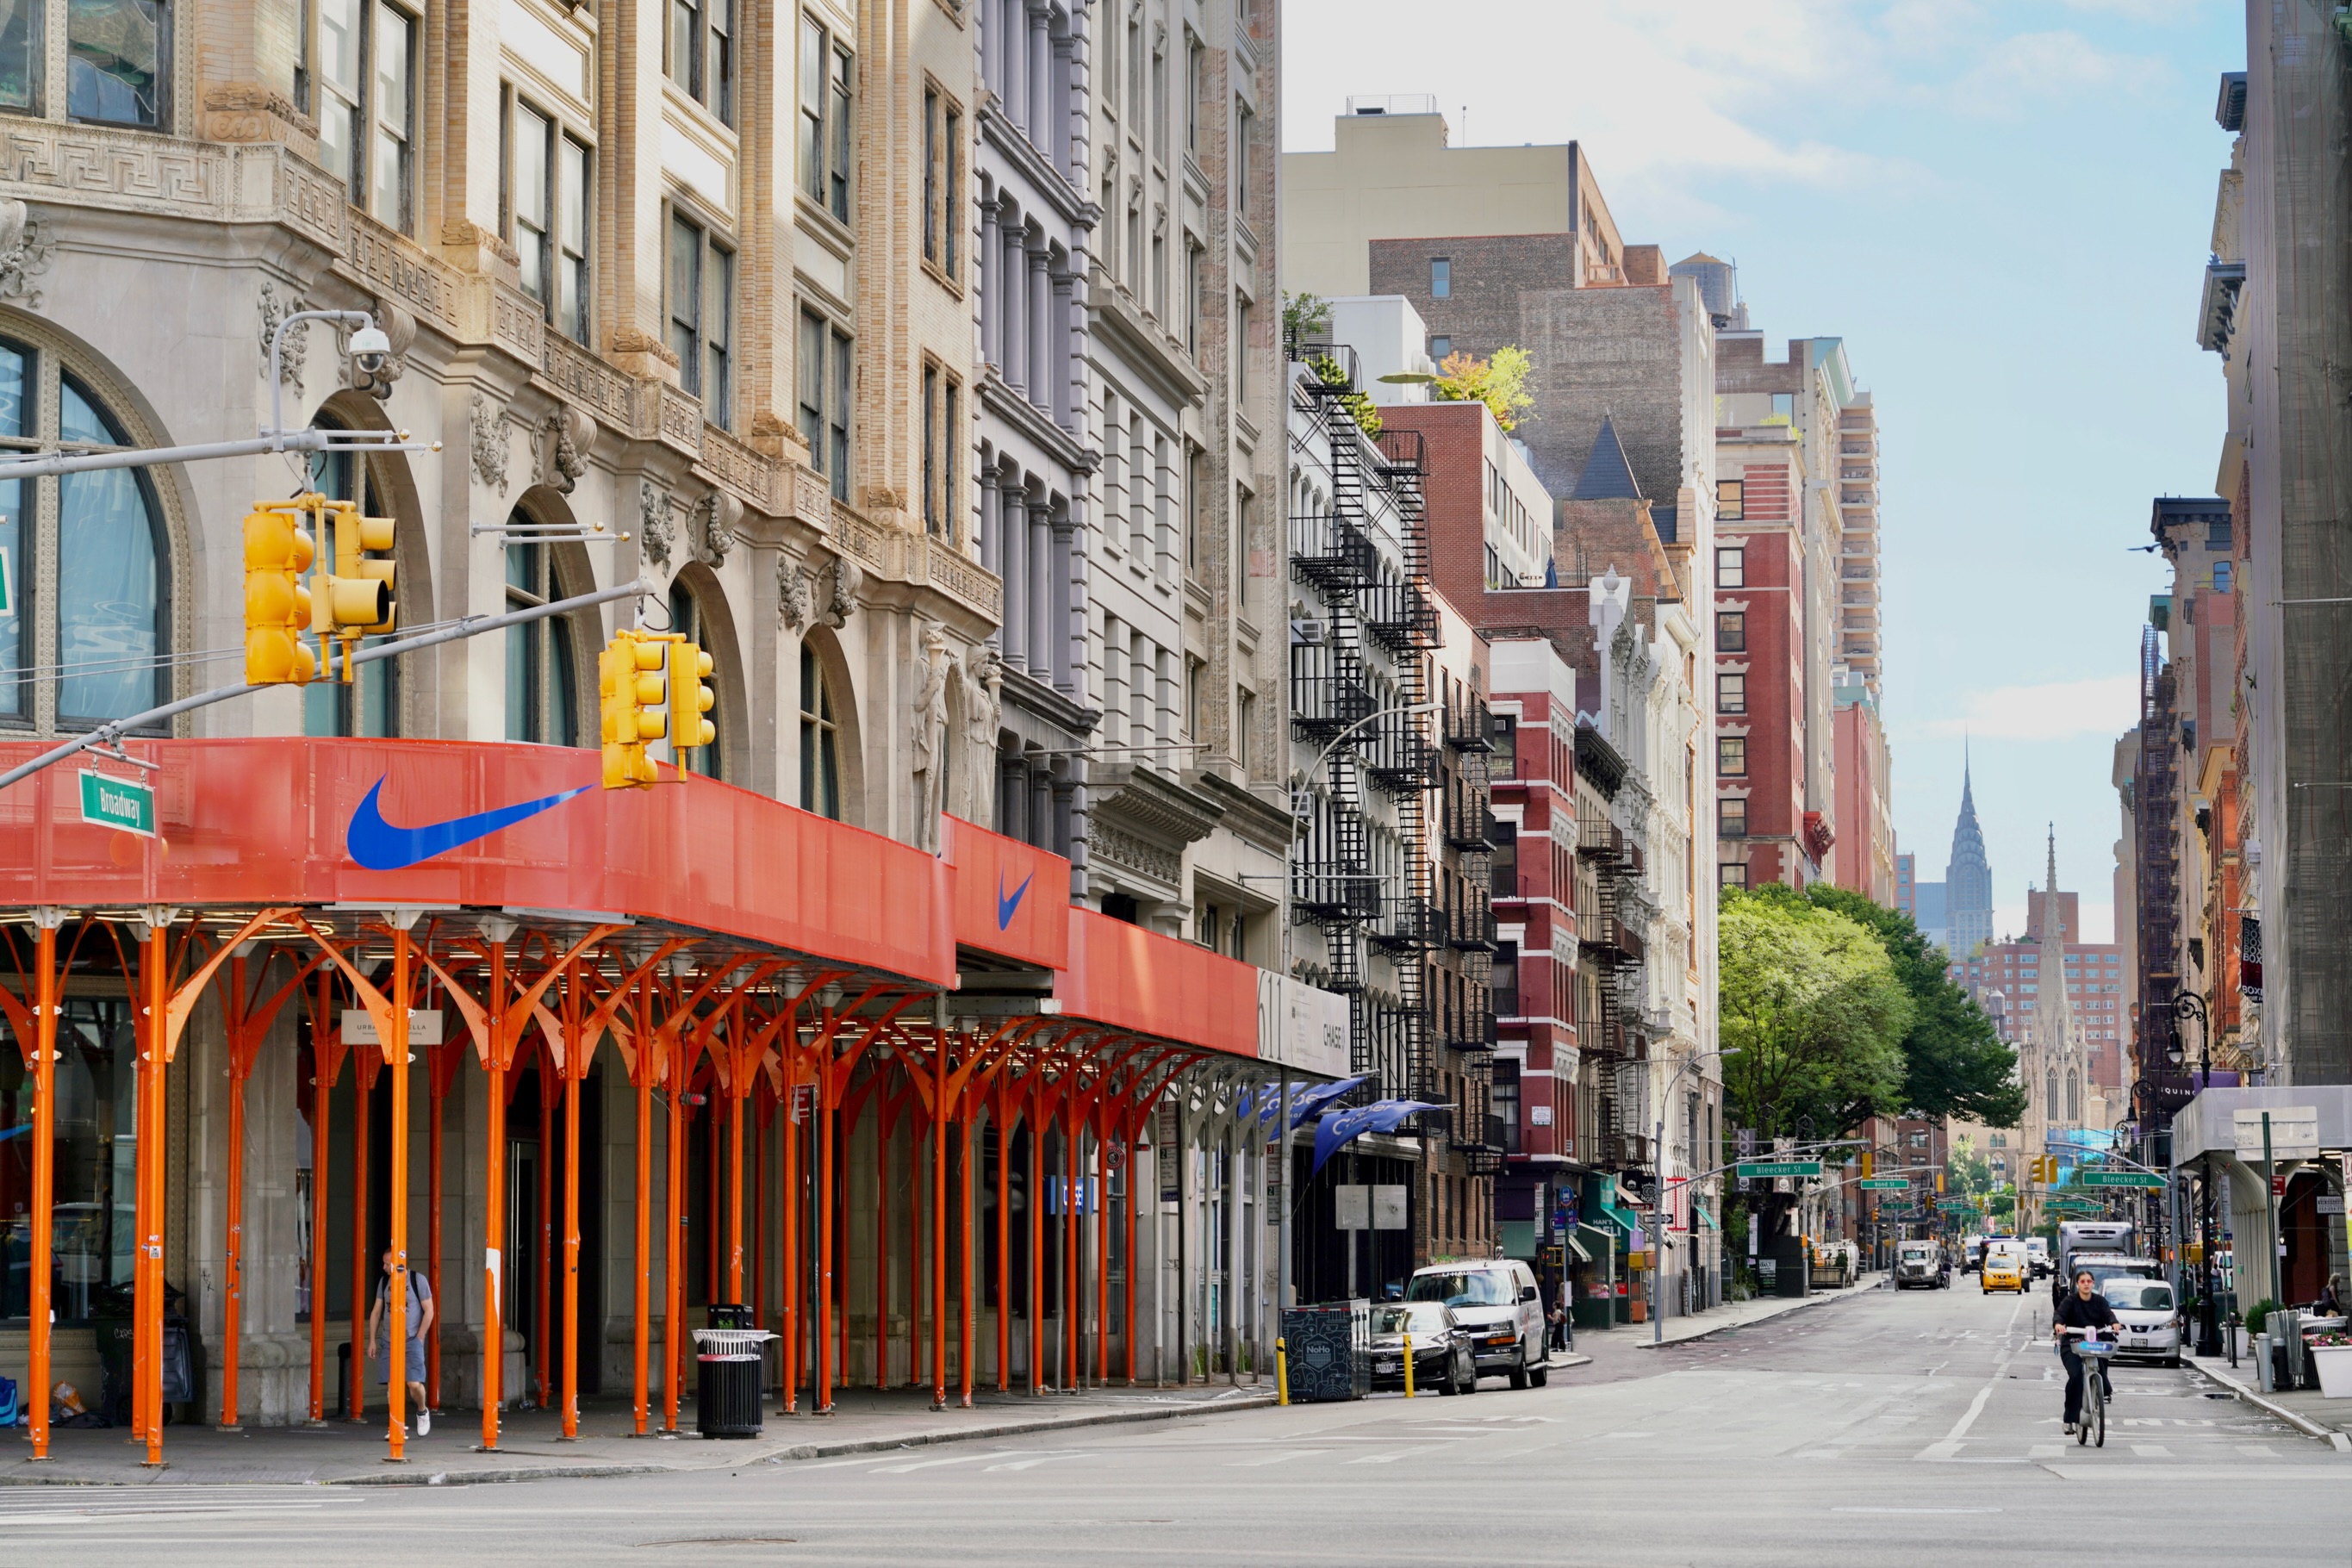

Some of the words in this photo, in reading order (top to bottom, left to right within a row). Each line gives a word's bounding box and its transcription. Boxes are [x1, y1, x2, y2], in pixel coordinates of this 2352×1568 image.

[100, 787, 140, 827] Broadway
[1257, 970, 1283, 1061] 611
[1323, 1024, 1341, 1049] CHASE
[2102, 1175, 2137, 1185] Bleecker
